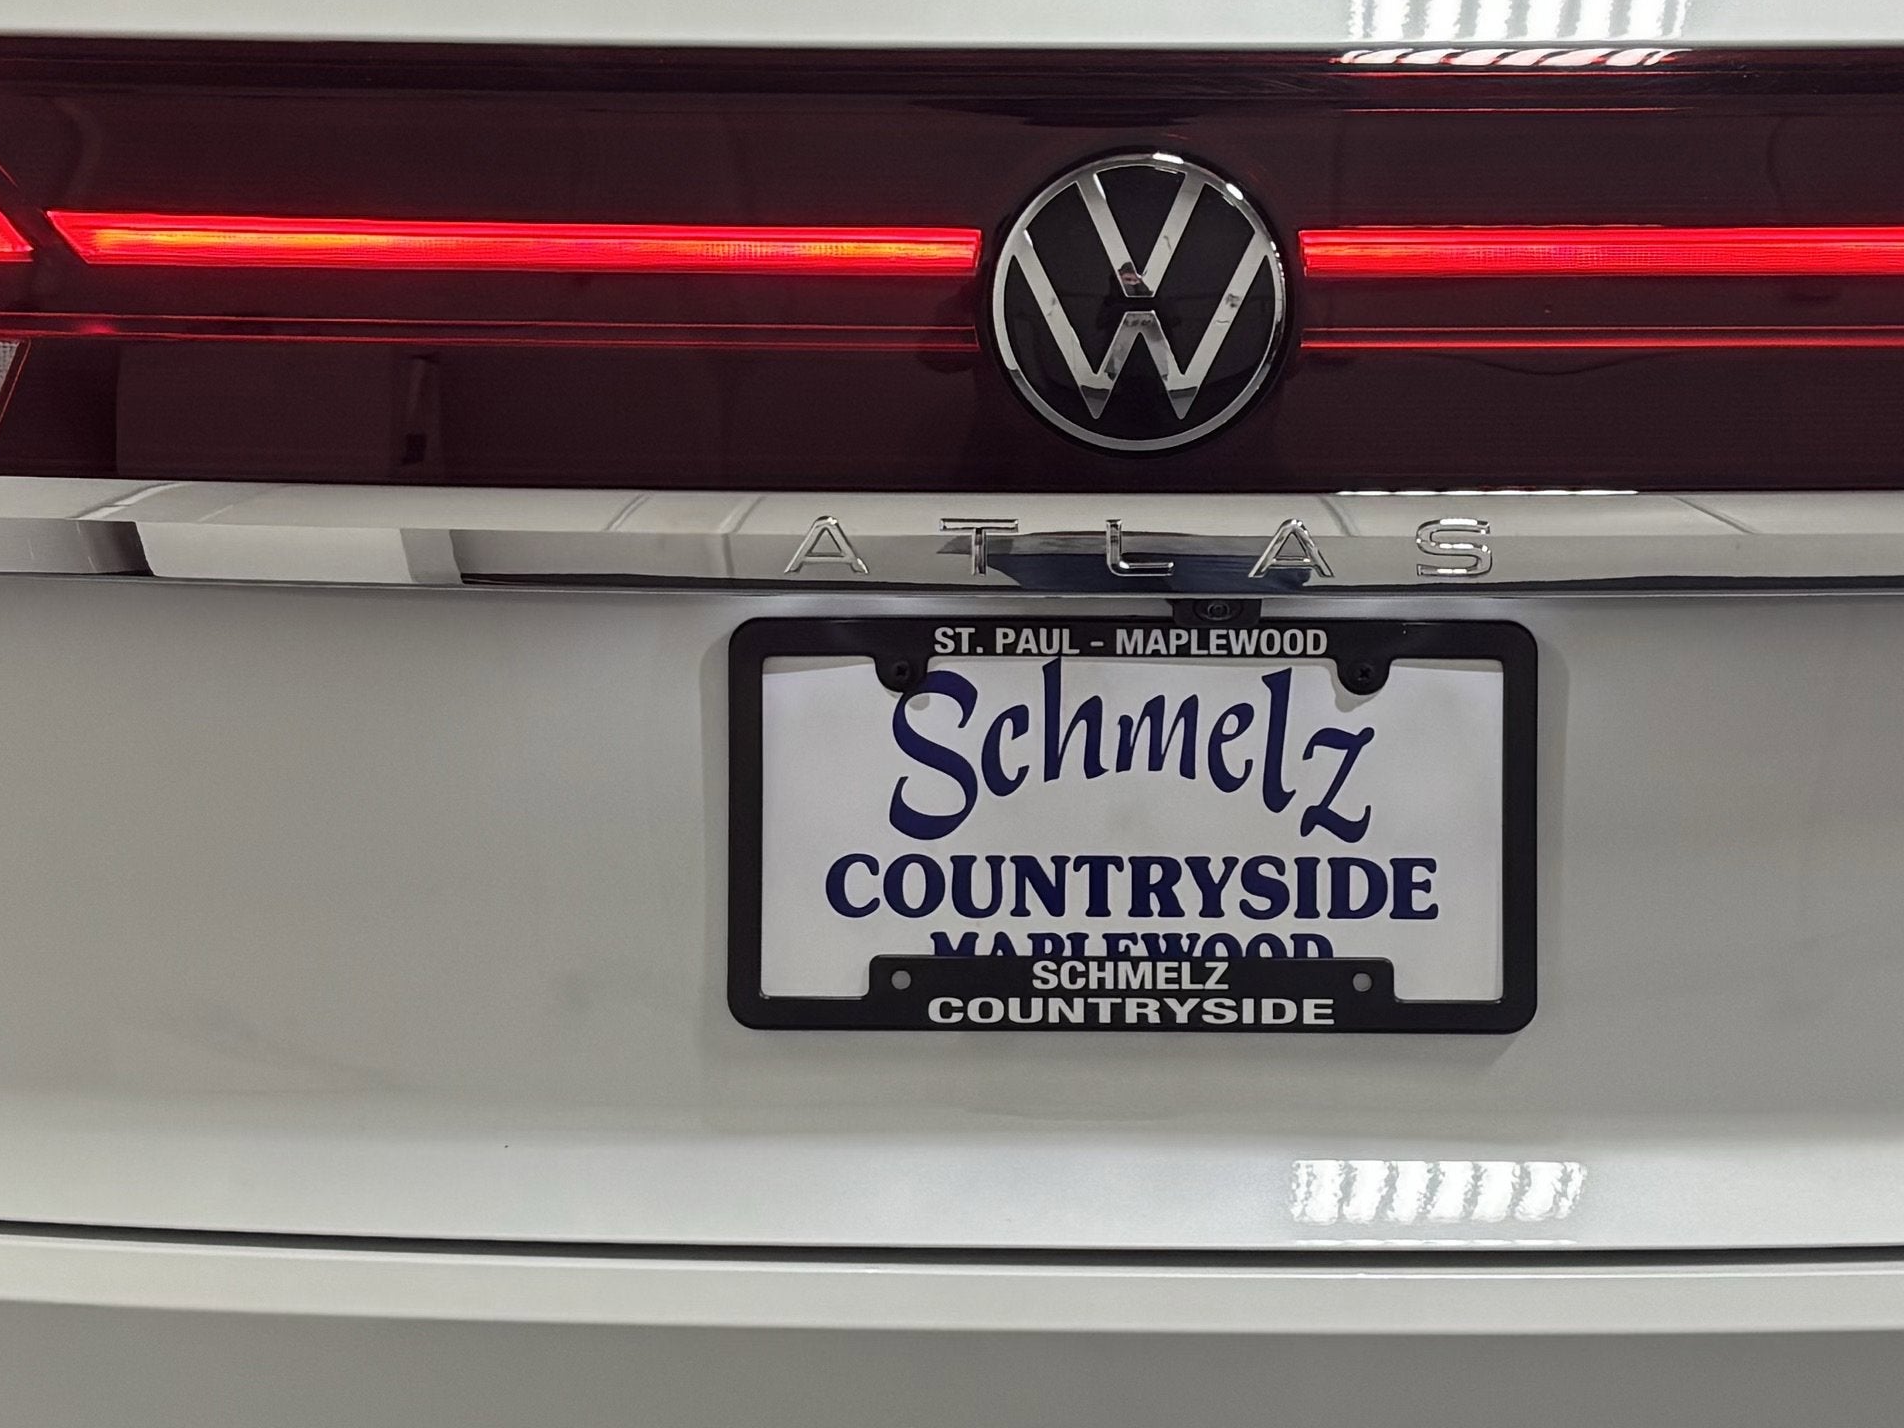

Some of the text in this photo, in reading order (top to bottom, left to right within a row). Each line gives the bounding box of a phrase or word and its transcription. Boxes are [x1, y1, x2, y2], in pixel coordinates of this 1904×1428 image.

[783, 515, 1492, 578] ATLAS
[934, 627, 985, 655] ST.
[995, 627, 1080, 655] PAUL
[1115, 628, 1329, 657] MAPLEWOOD
[889, 655, 1375, 843] Schmelz
[825, 853, 1440, 920] COUNTRYSIDE
[1032, 960, 1229, 990] SCHMELZ
[928, 997, 1335, 1025] COUNTRYSIDE
